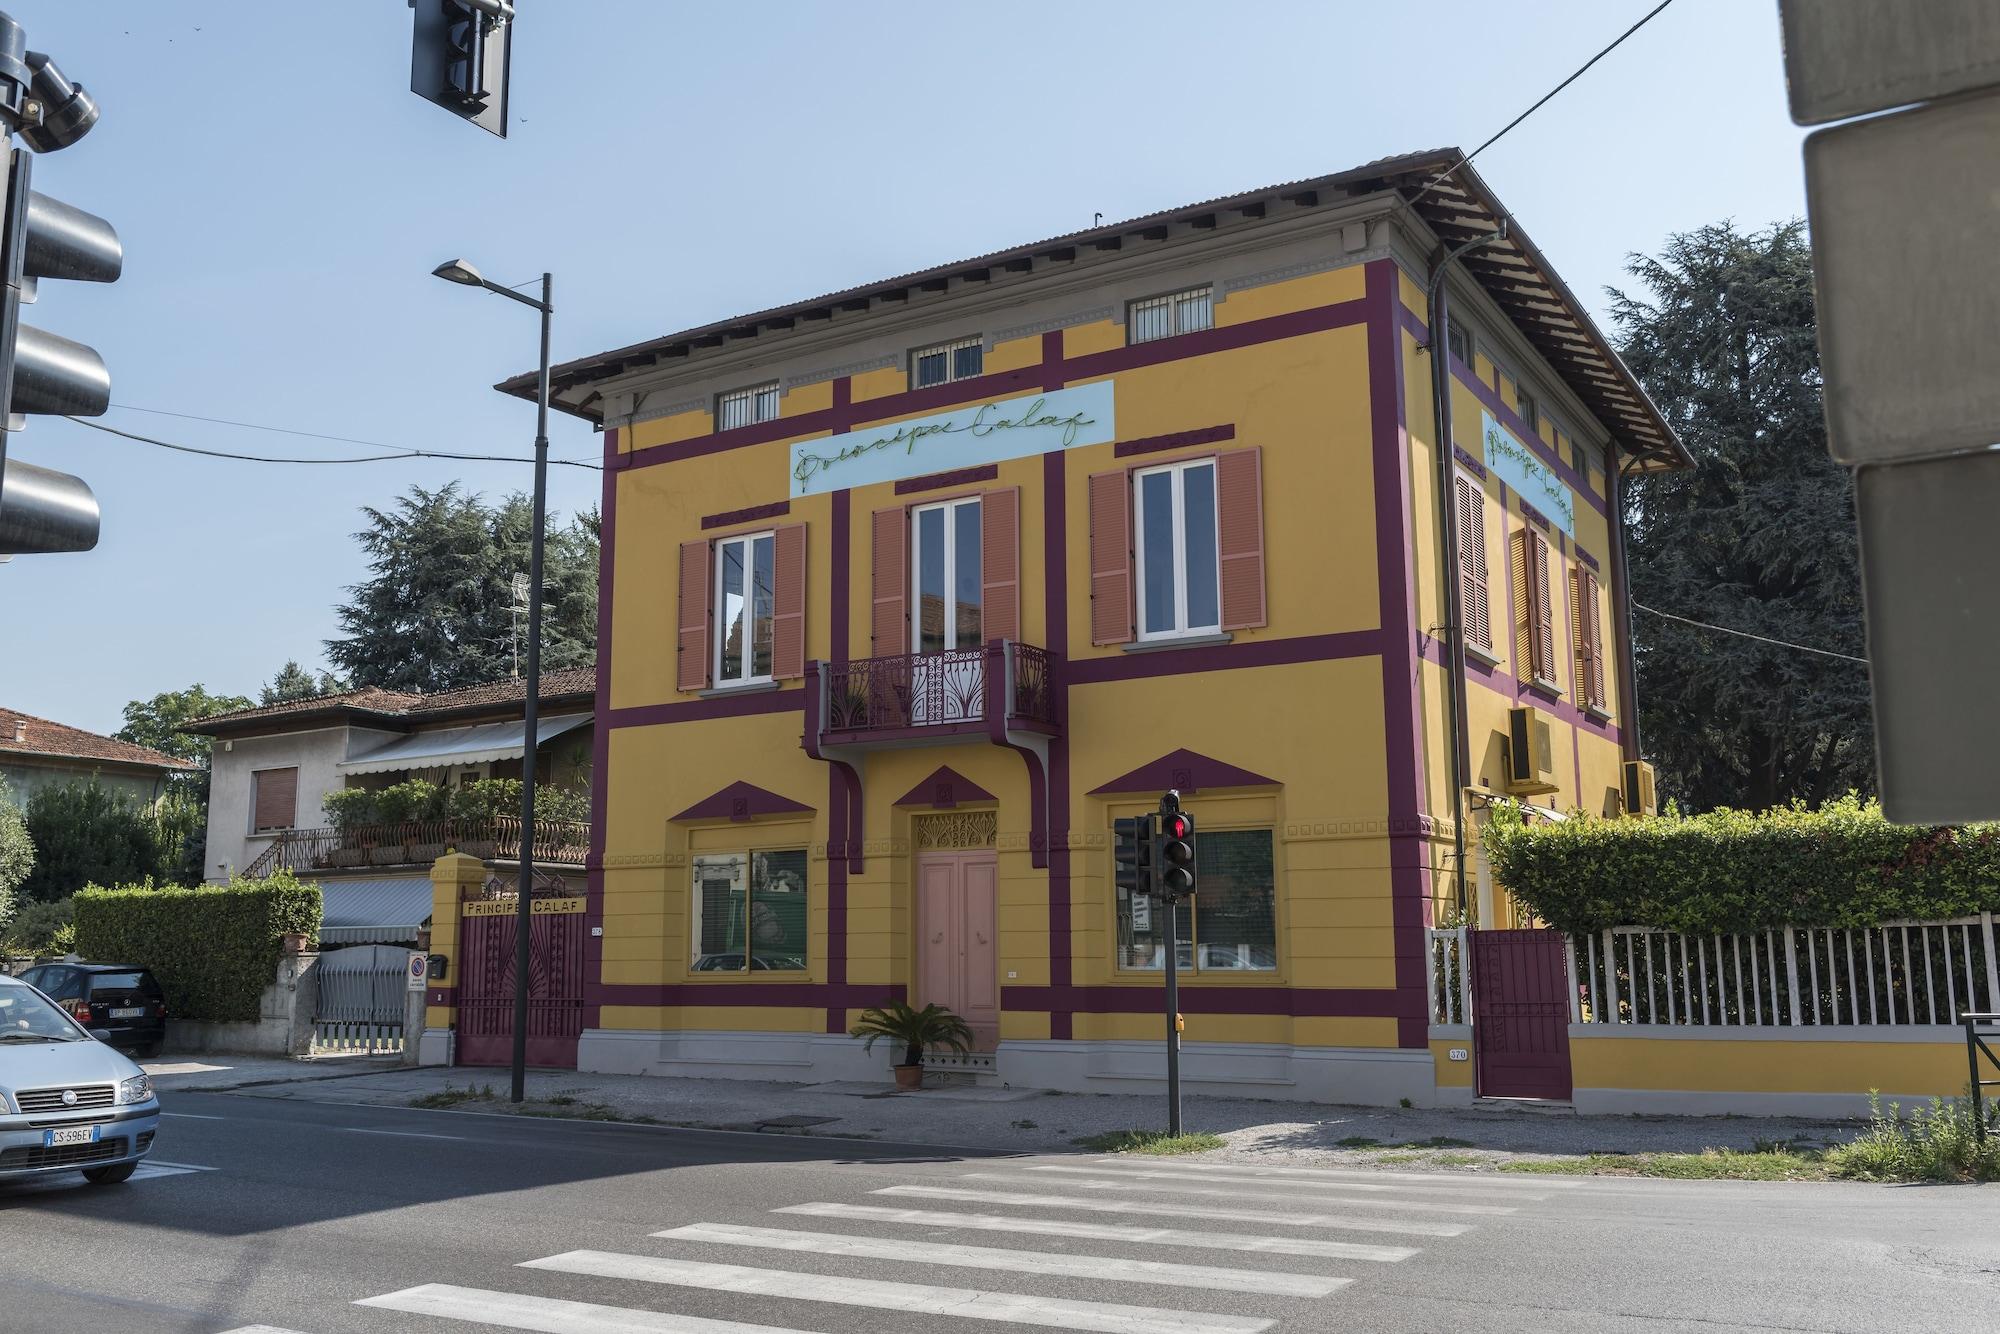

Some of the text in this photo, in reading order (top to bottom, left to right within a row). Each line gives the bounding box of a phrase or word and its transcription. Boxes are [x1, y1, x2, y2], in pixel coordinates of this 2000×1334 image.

[972, 398, 1095, 446] Calaf
[467, 901, 578, 915] PRINCIPE CALAF
[1451, 1050, 1466, 1059] 370
